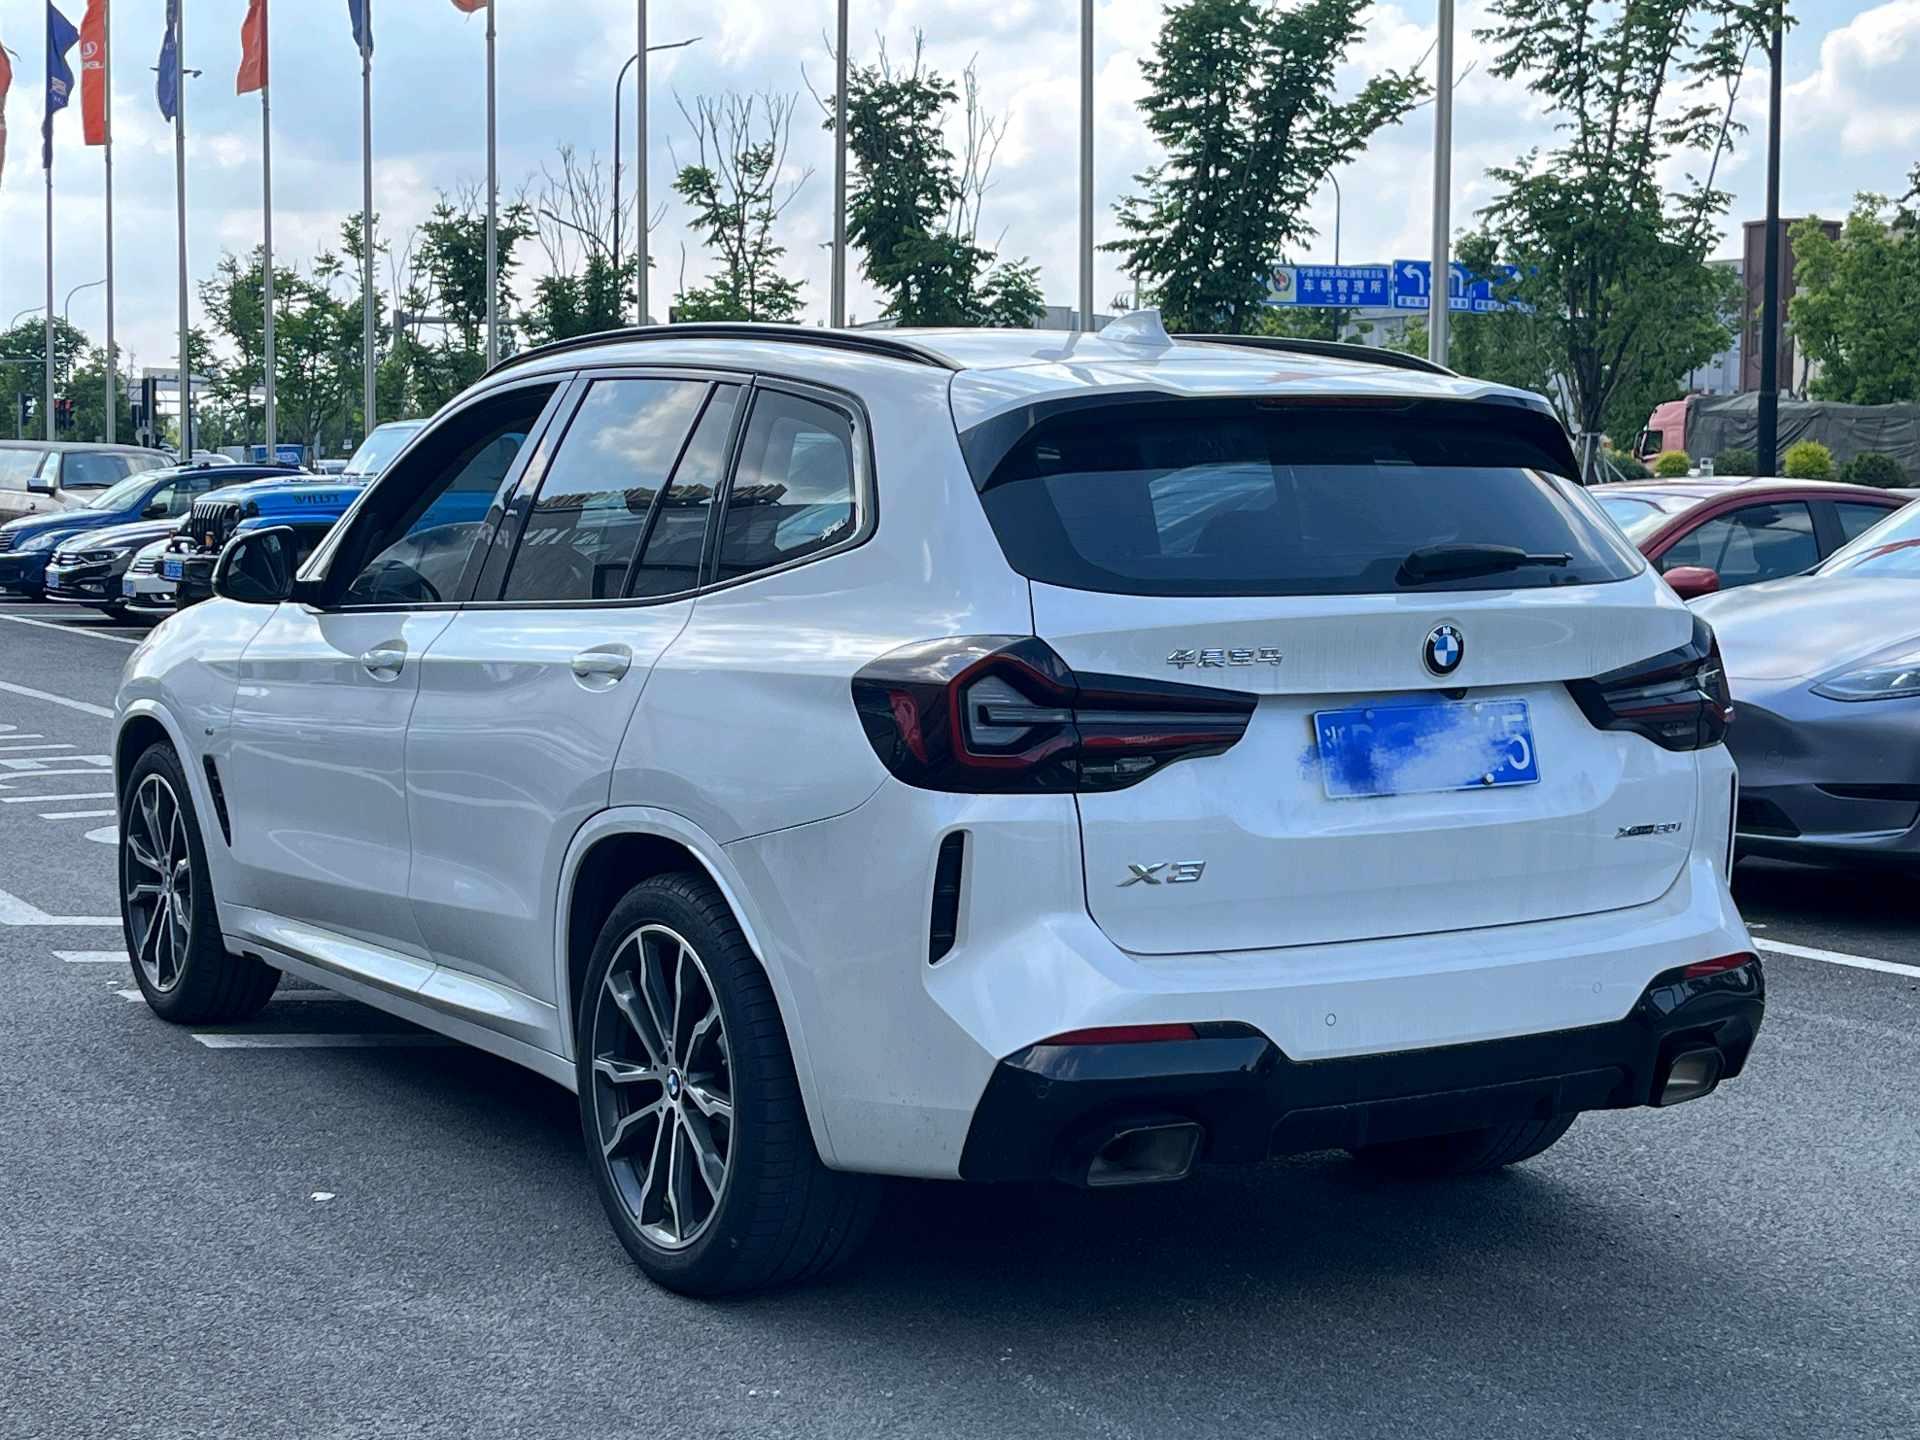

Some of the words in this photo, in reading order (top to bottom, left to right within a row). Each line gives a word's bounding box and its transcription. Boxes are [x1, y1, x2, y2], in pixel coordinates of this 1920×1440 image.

[1166, 647, 1283, 669] 华晨宝马
[1115, 860, 1207, 887] X3
